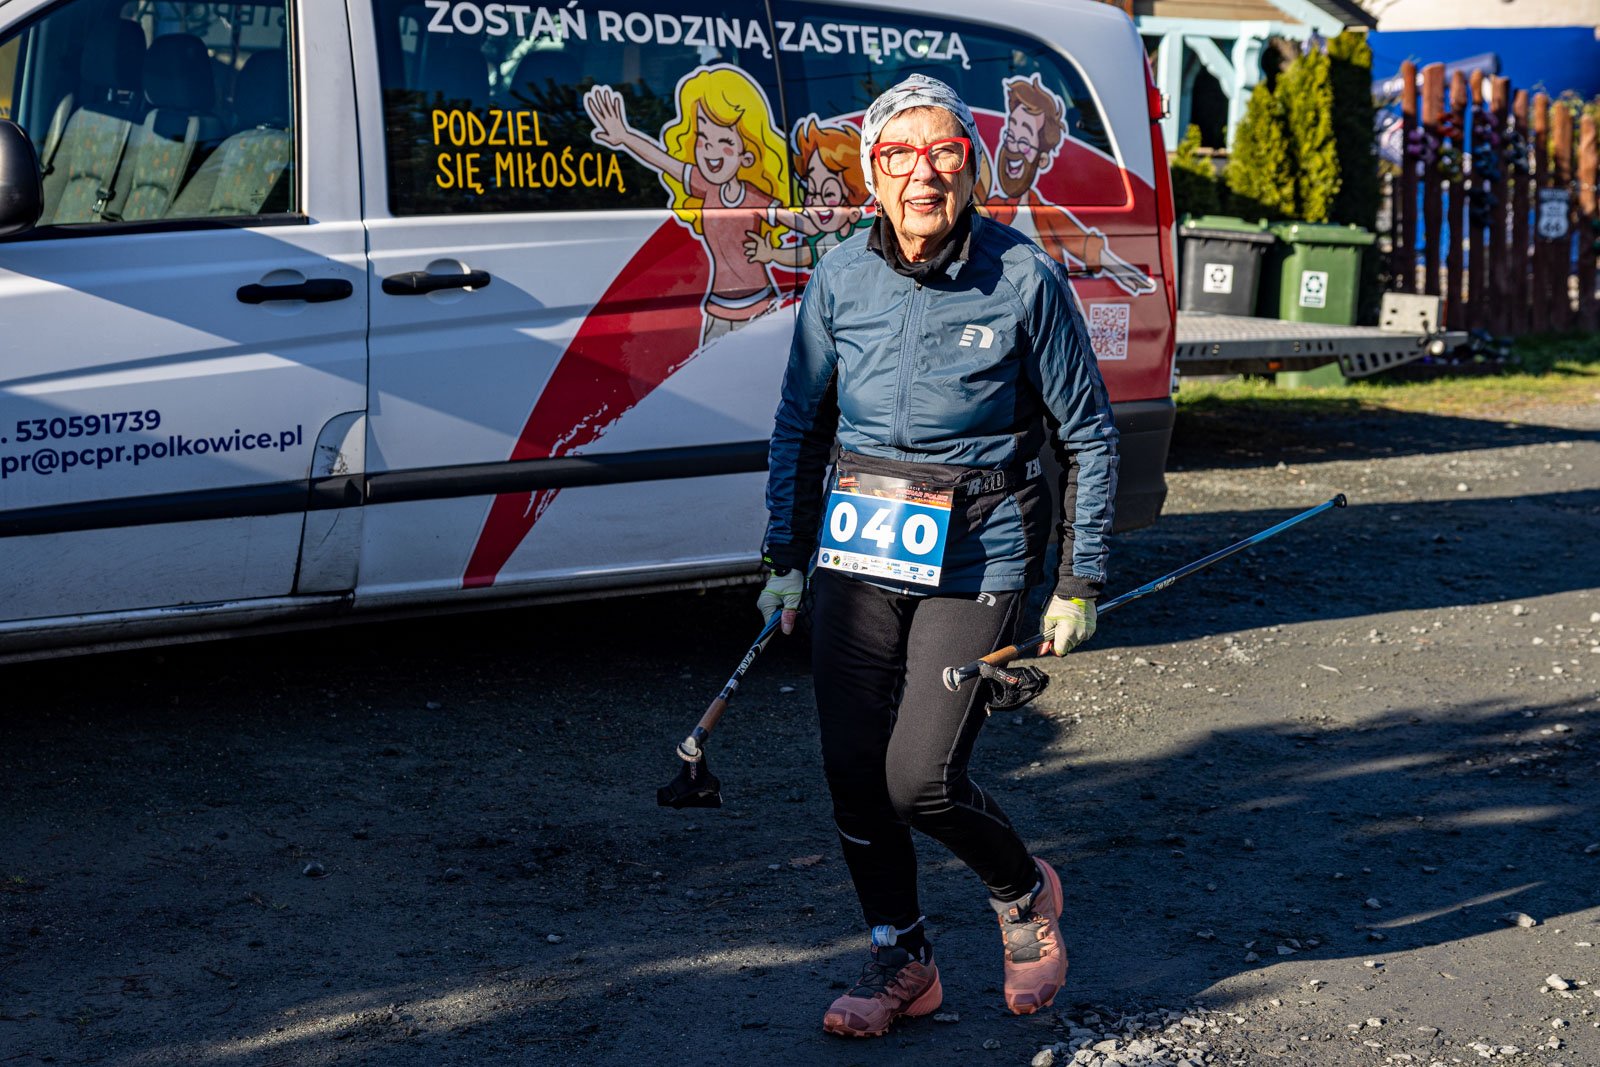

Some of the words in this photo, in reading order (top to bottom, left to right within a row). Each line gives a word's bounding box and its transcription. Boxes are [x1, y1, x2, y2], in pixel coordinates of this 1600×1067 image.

[425, 0, 588, 41] ZOSTAŃ
[599, 11, 773, 59] RODZINĄ
[777, 22, 971, 69] ZASTĘPCZĄ
[432, 109, 548, 146] PODZIEL
[436, 153, 484, 194] SIĘ
[495, 146, 626, 194] MIŁOŚCIĄ
[15, 409, 161, 443] 530591739
[1, 424, 303, 480] pr@pcpr.polkowice.pl
[830, 501, 939, 556] 040
